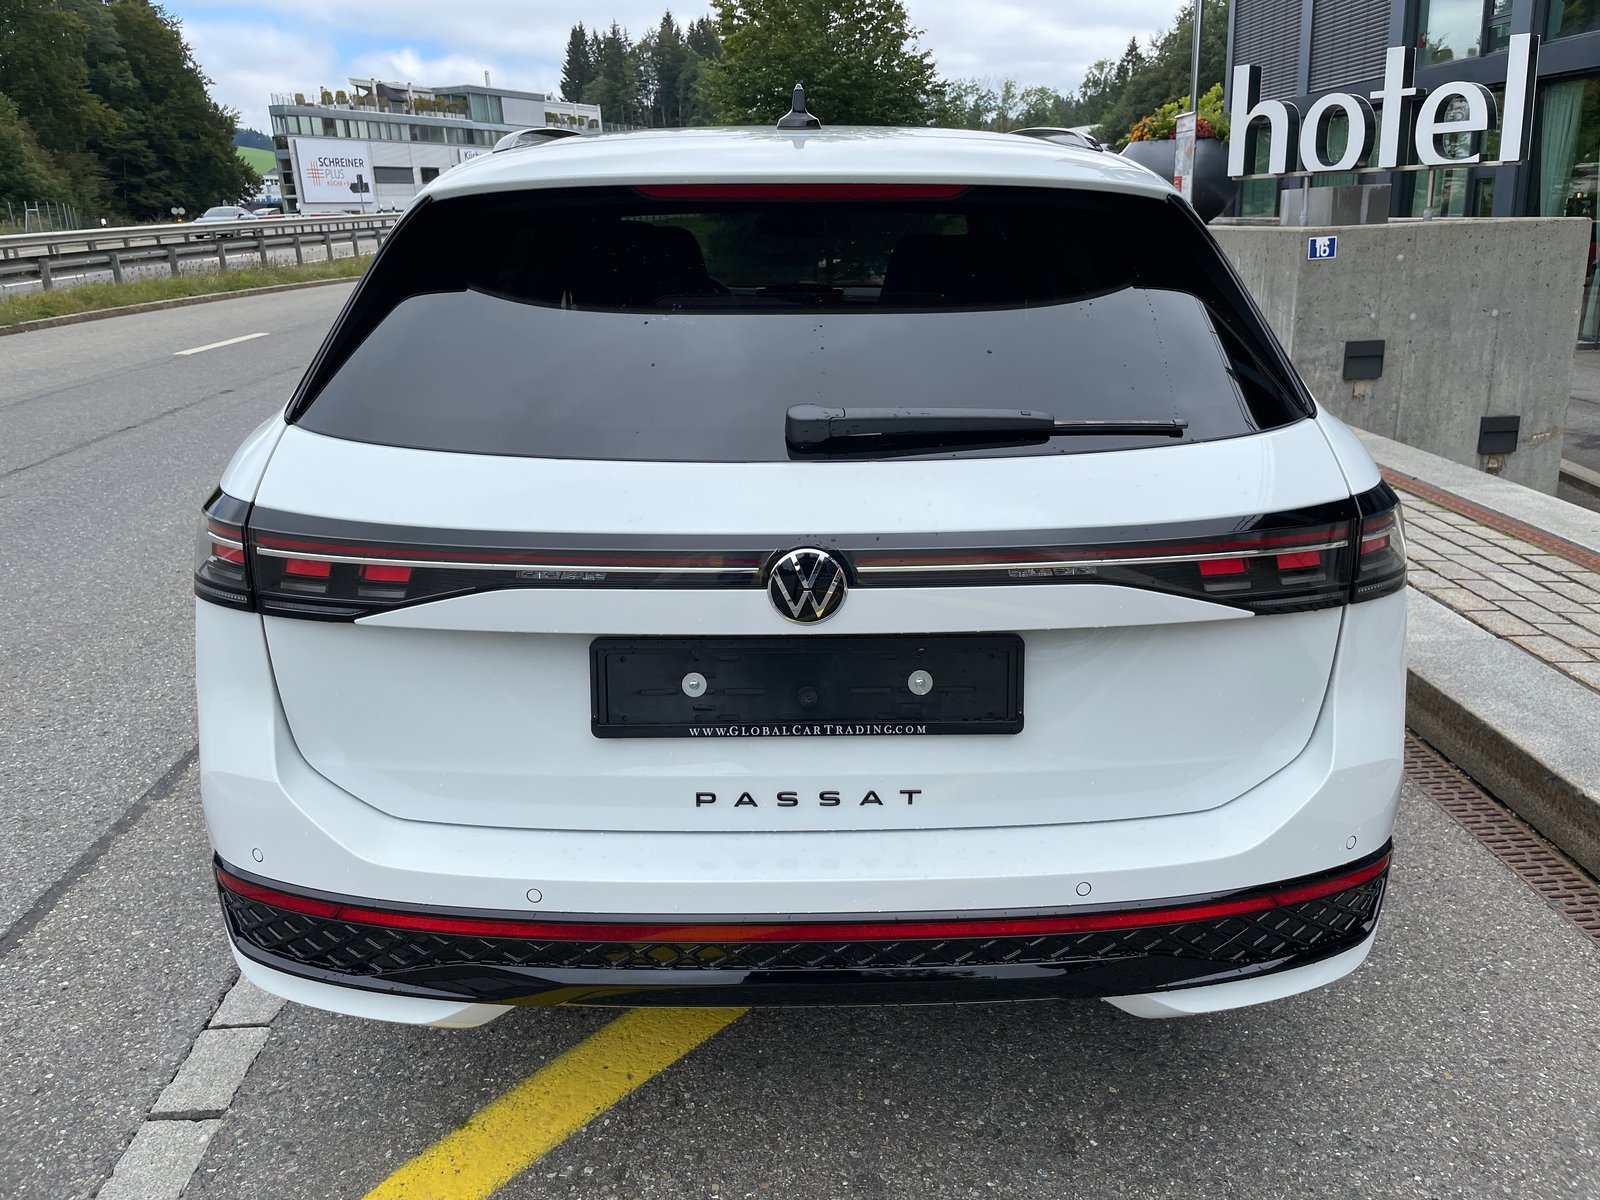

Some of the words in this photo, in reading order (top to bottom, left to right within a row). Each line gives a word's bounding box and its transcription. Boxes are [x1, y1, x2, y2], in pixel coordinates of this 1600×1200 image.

[1227, 33, 1540, 178] hotel
[318, 156, 365, 168] SCHREINER
[325, 169, 345, 179] PLUS
[1315, 239, 1330, 257] 16
[695, 789, 922, 808] PASSAT
